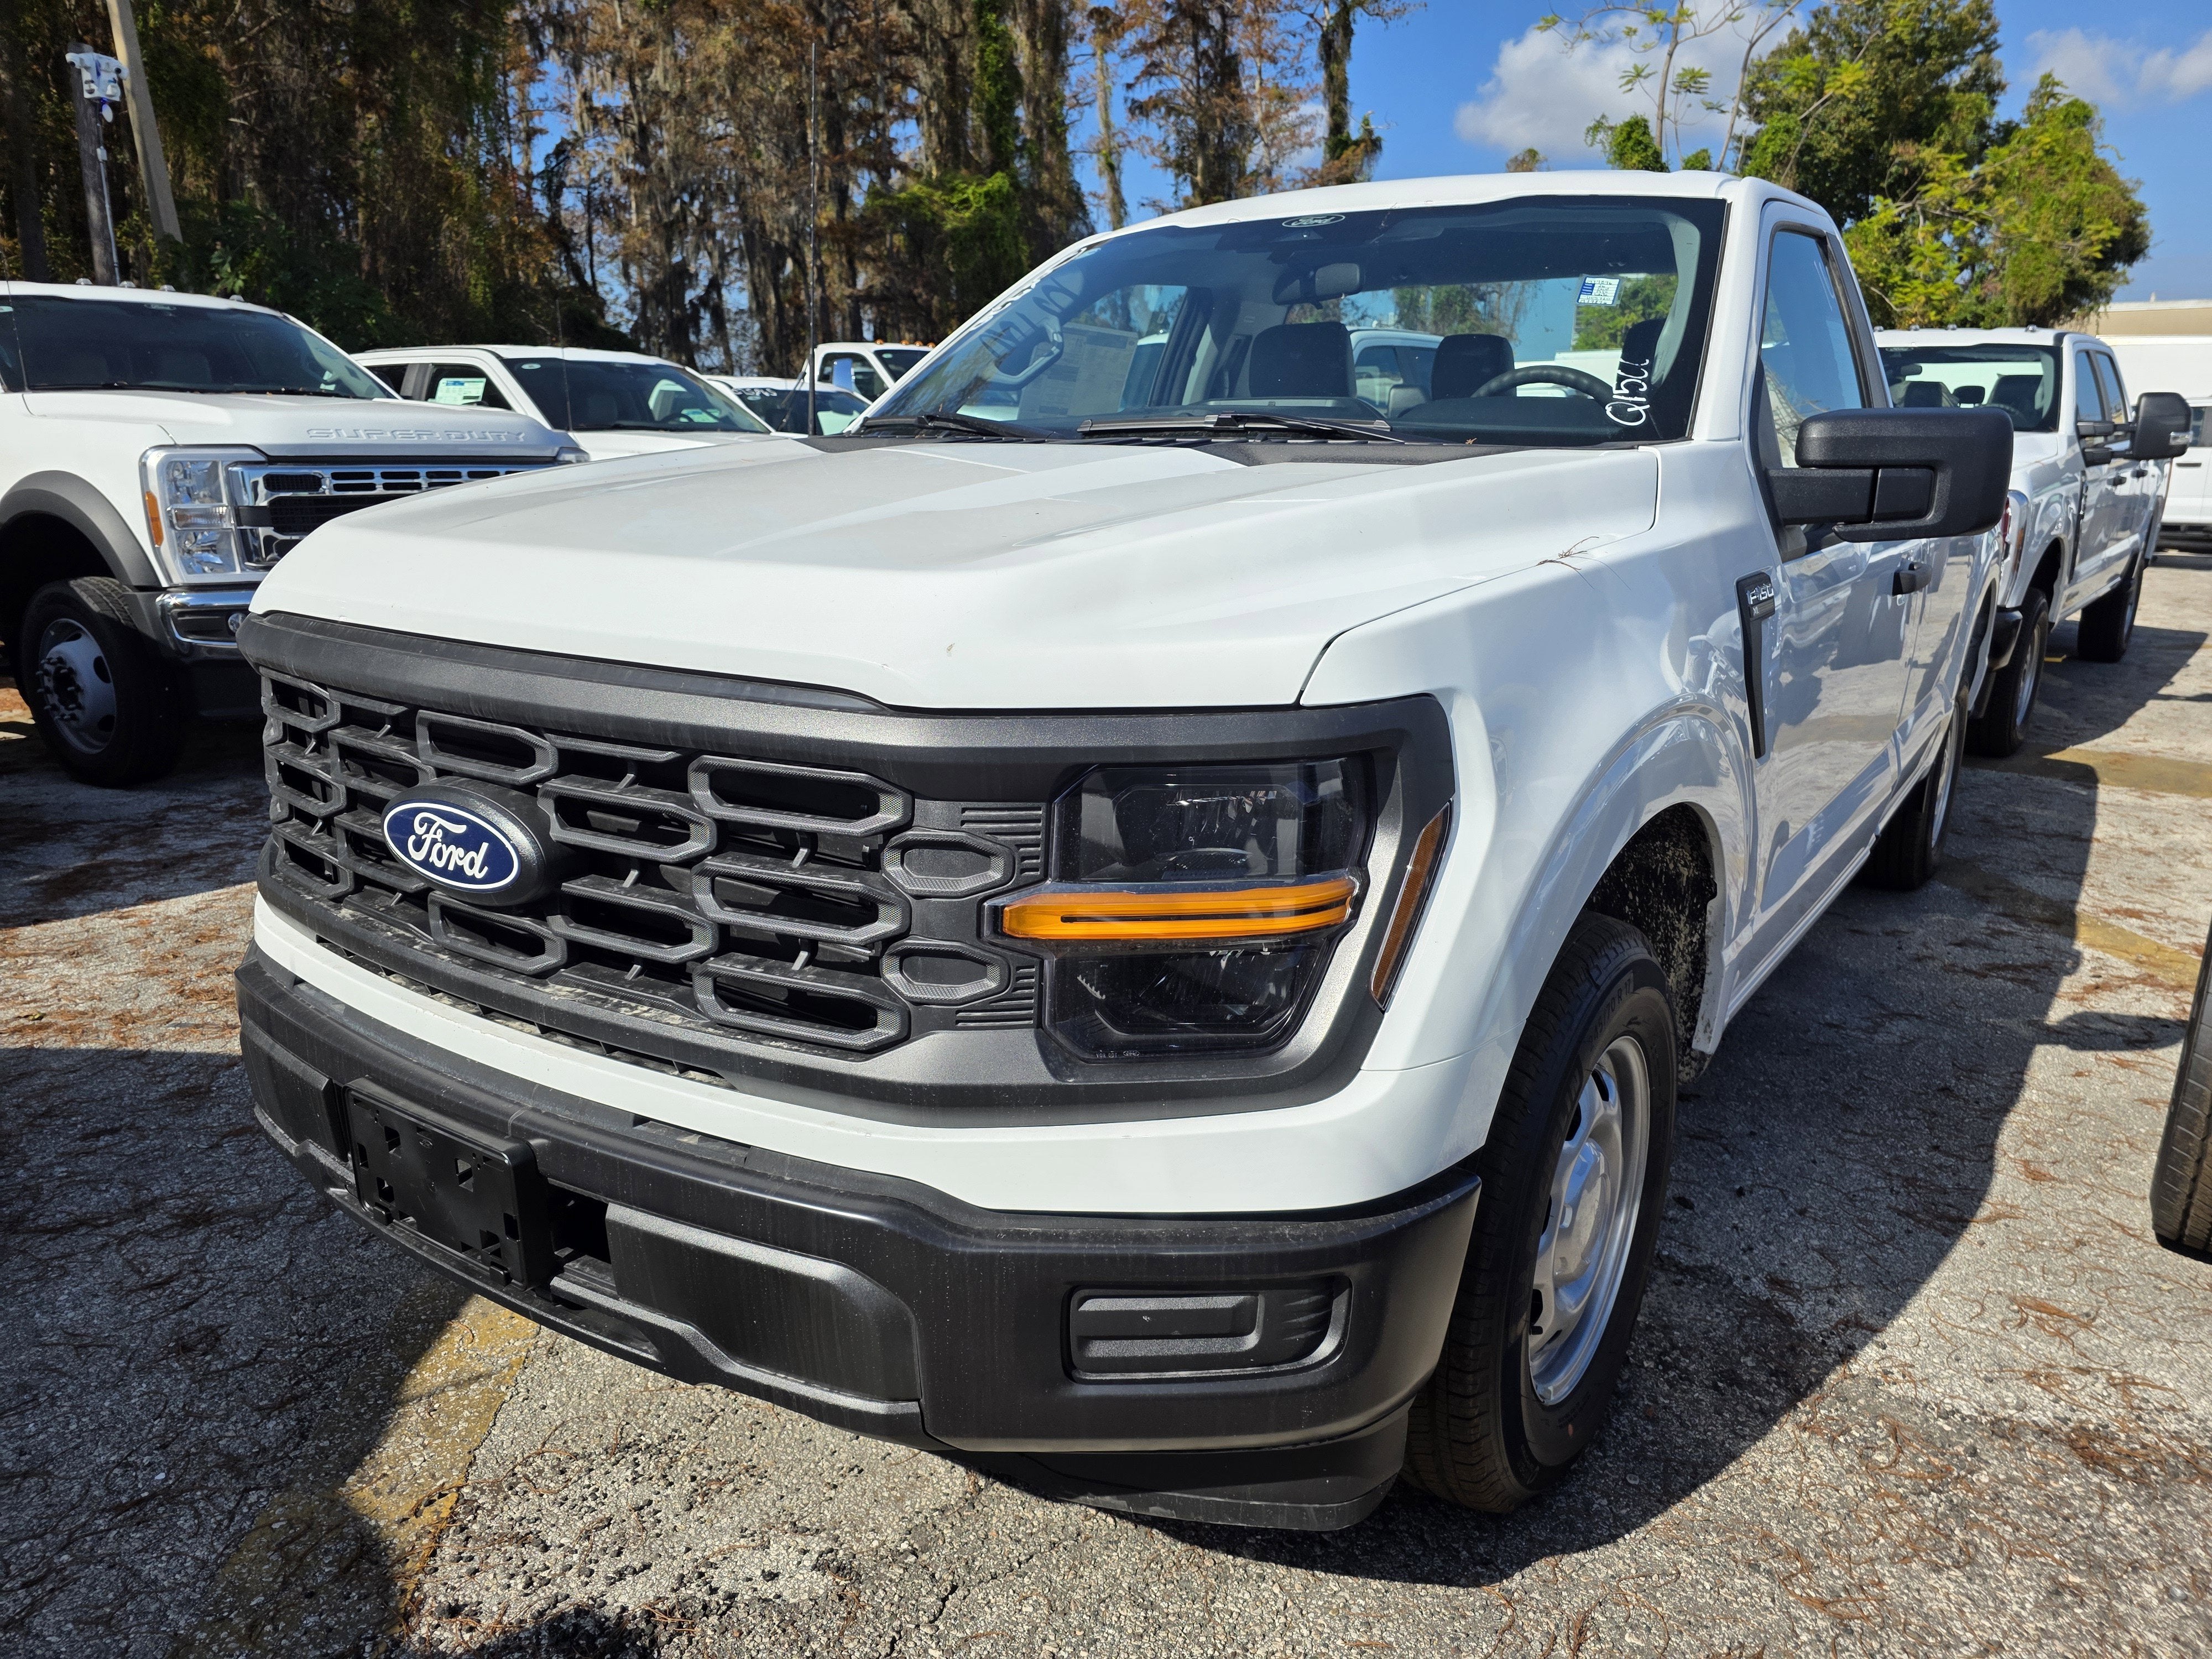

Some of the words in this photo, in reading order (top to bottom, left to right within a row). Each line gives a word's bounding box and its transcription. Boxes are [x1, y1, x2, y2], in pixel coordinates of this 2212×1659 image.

[1291, 216, 1336, 226] Ford
[306, 429, 442, 441] SUPER
[444, 430, 525, 442] DUTY
[408, 812, 489, 879] Ford
